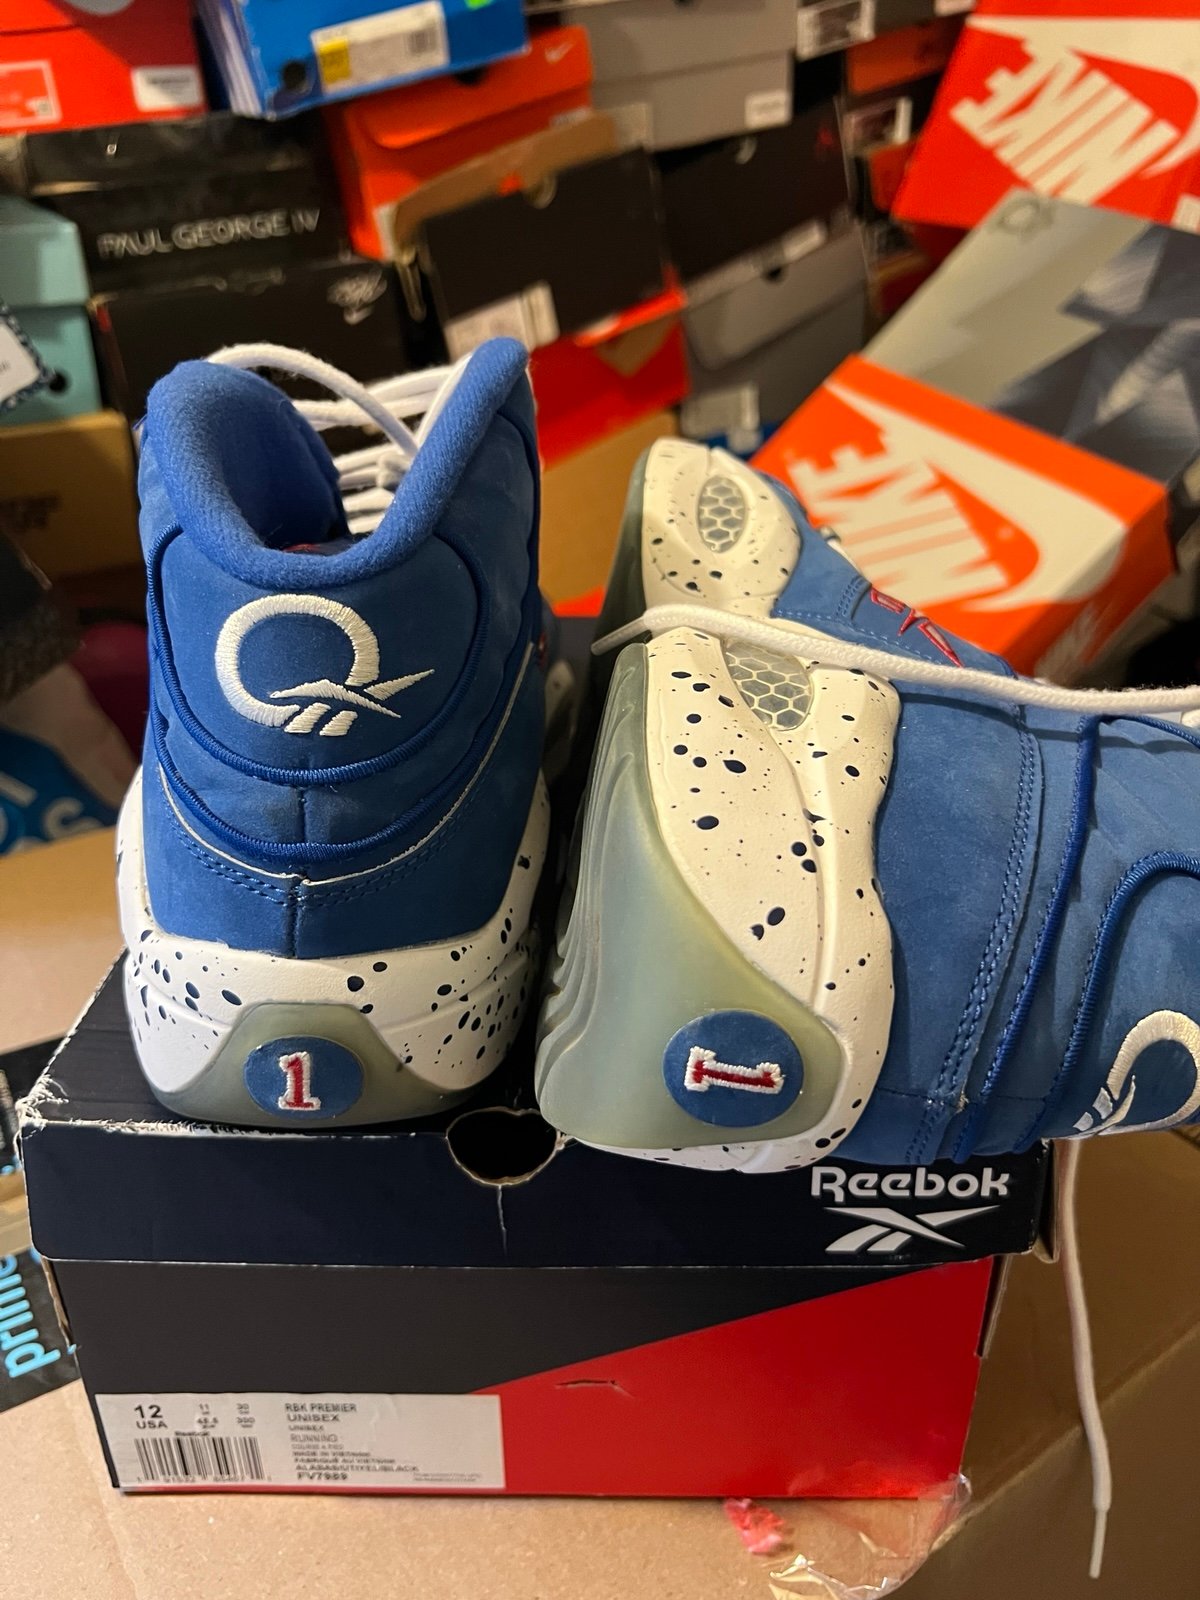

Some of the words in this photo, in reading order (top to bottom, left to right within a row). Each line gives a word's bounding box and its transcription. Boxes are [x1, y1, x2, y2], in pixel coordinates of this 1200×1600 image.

[950, 35, 1181, 206] NIKE
[97, 228, 172, 259] PAUL
[171, 208, 291, 250] GEORGE
[291, 207, 320, 233] IV
[783, 420, 1010, 602] NIKE
[278, 1051, 321, 1111] 1
[811, 1166, 1010, 1203] Reebok
[134, 1404, 163, 1419] 12
[136, 1420, 168, 1430] USA
[285, 1403, 308, 1413] RBK
[310, 1403, 357, 1413] PREMIER
[287, 1413, 341, 1422] UNISEX
